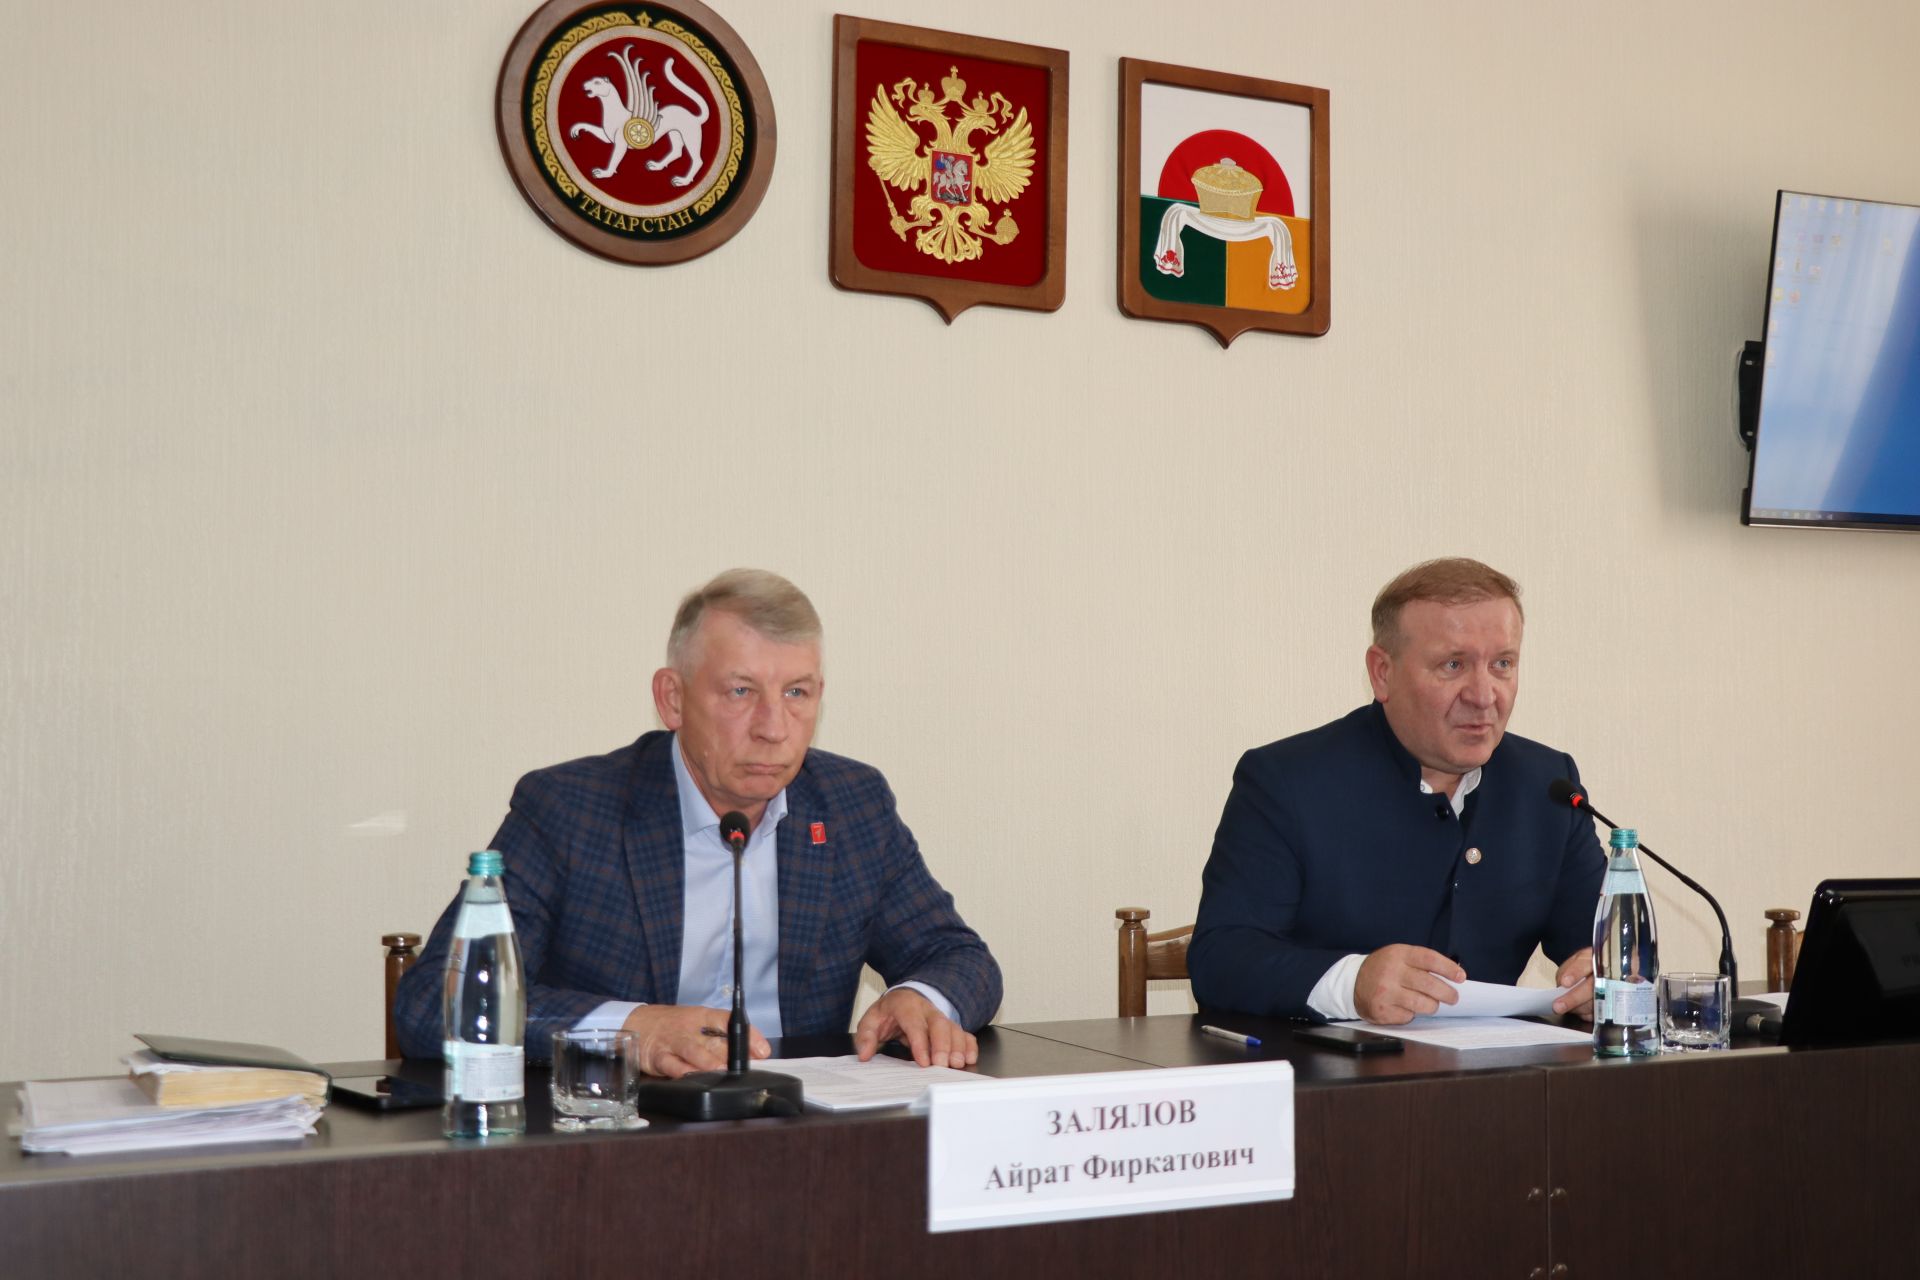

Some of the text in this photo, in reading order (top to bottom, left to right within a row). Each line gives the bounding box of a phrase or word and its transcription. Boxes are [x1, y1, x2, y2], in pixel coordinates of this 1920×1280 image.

[580, 196, 694, 233] ТАТАРСТАН
[1047, 1099, 1197, 1135] ЗАЛЯЛОВ
[984, 1147, 1256, 1193] Айрат Фиркатович
